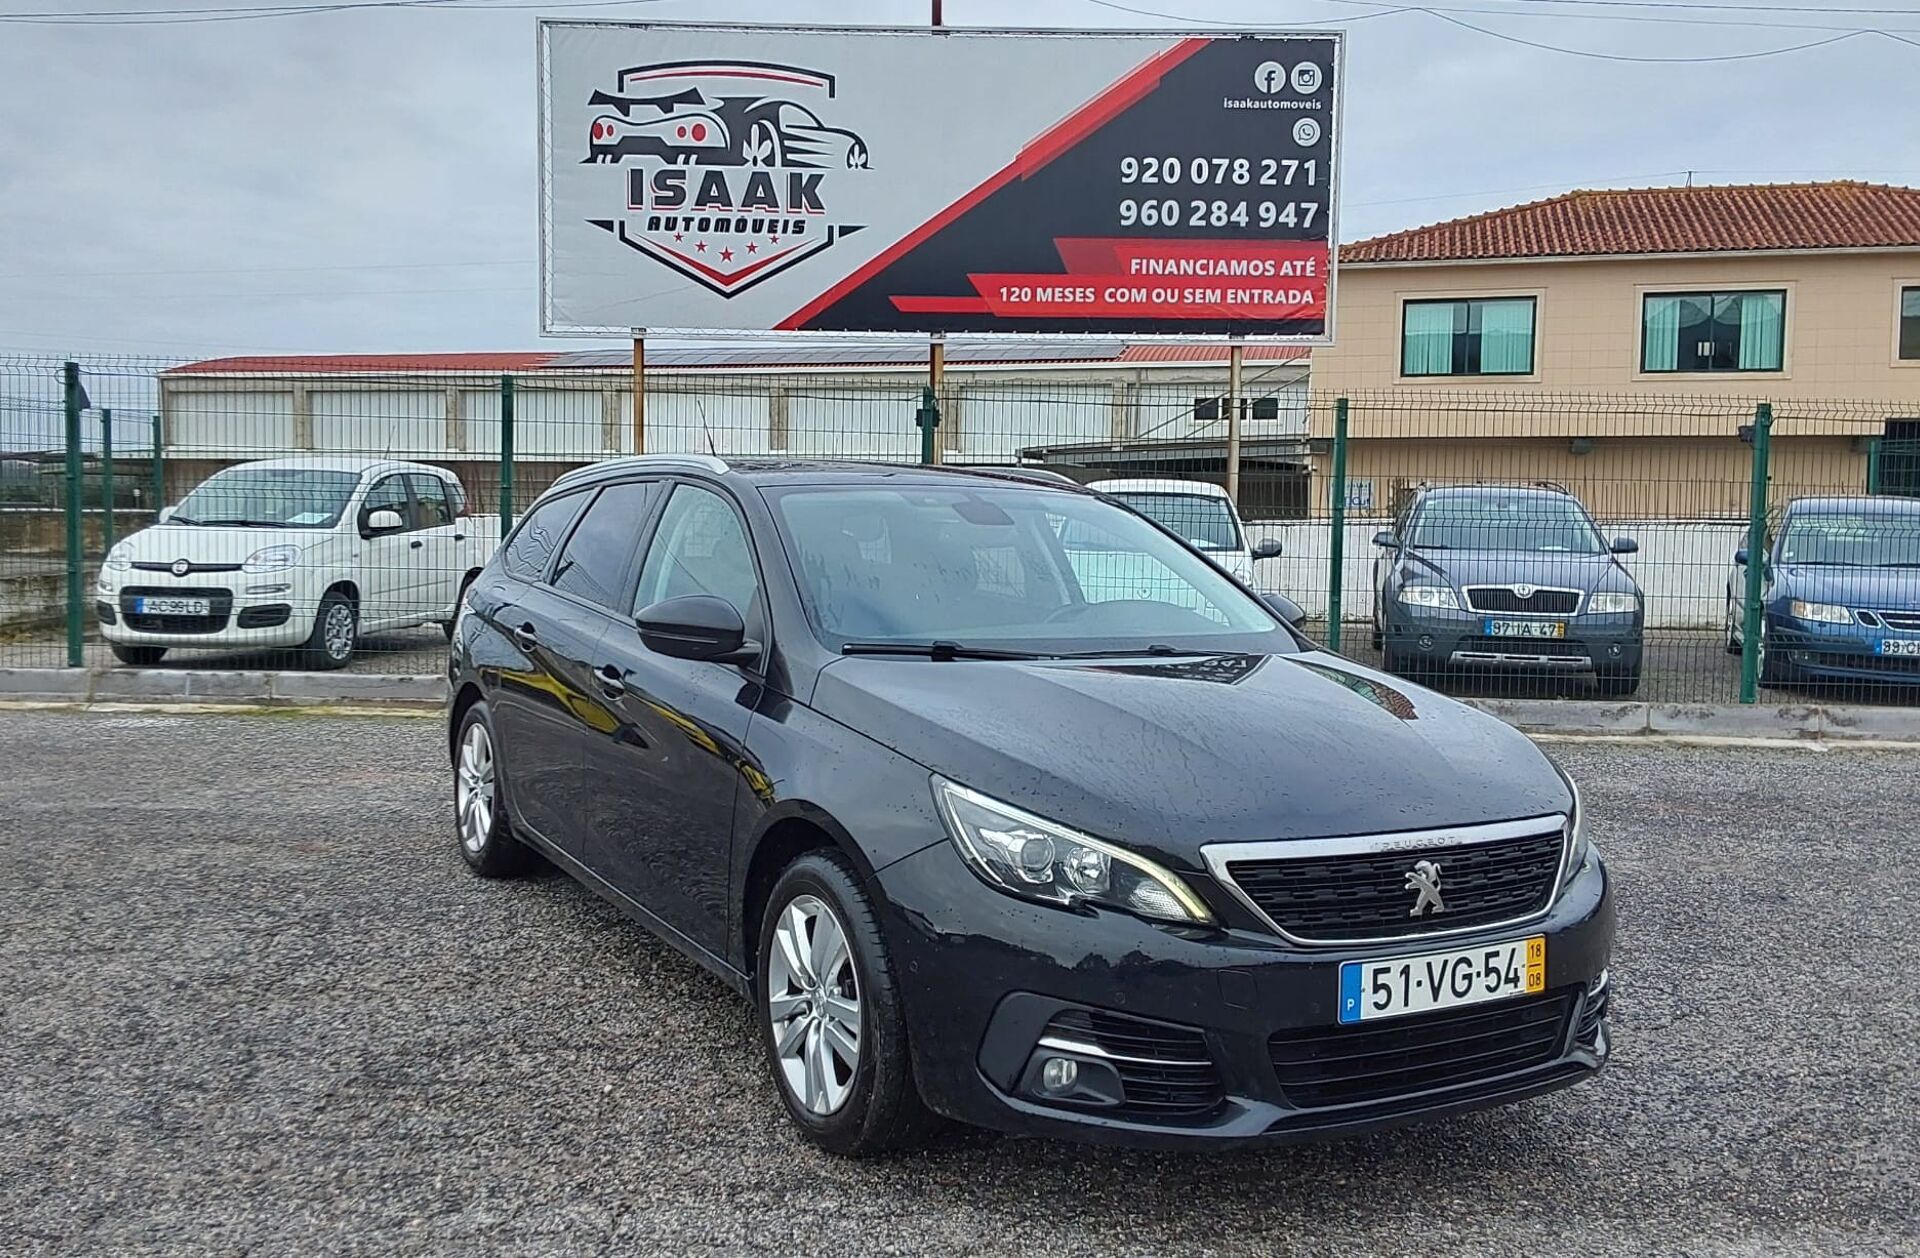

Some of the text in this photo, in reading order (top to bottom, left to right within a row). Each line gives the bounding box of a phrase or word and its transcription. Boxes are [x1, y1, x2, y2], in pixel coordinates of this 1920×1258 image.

[1223, 98, 1322, 110] isaakautomoveis
[1120, 157, 1316, 186] 920 078 271
[627, 168, 825, 215] ISAAK
[1119, 199, 1318, 228] 960 284 947
[1130, 257, 1316, 277] FINANCIAMOS ATÉ
[1000, 286, 1315, 304] 120 MESES COM OU SEM ENTRADA
[1530, 943, 1542, 960] 18
[1528, 972, 1541, 987] 08
[1347, 999, 1355, 1011] P
